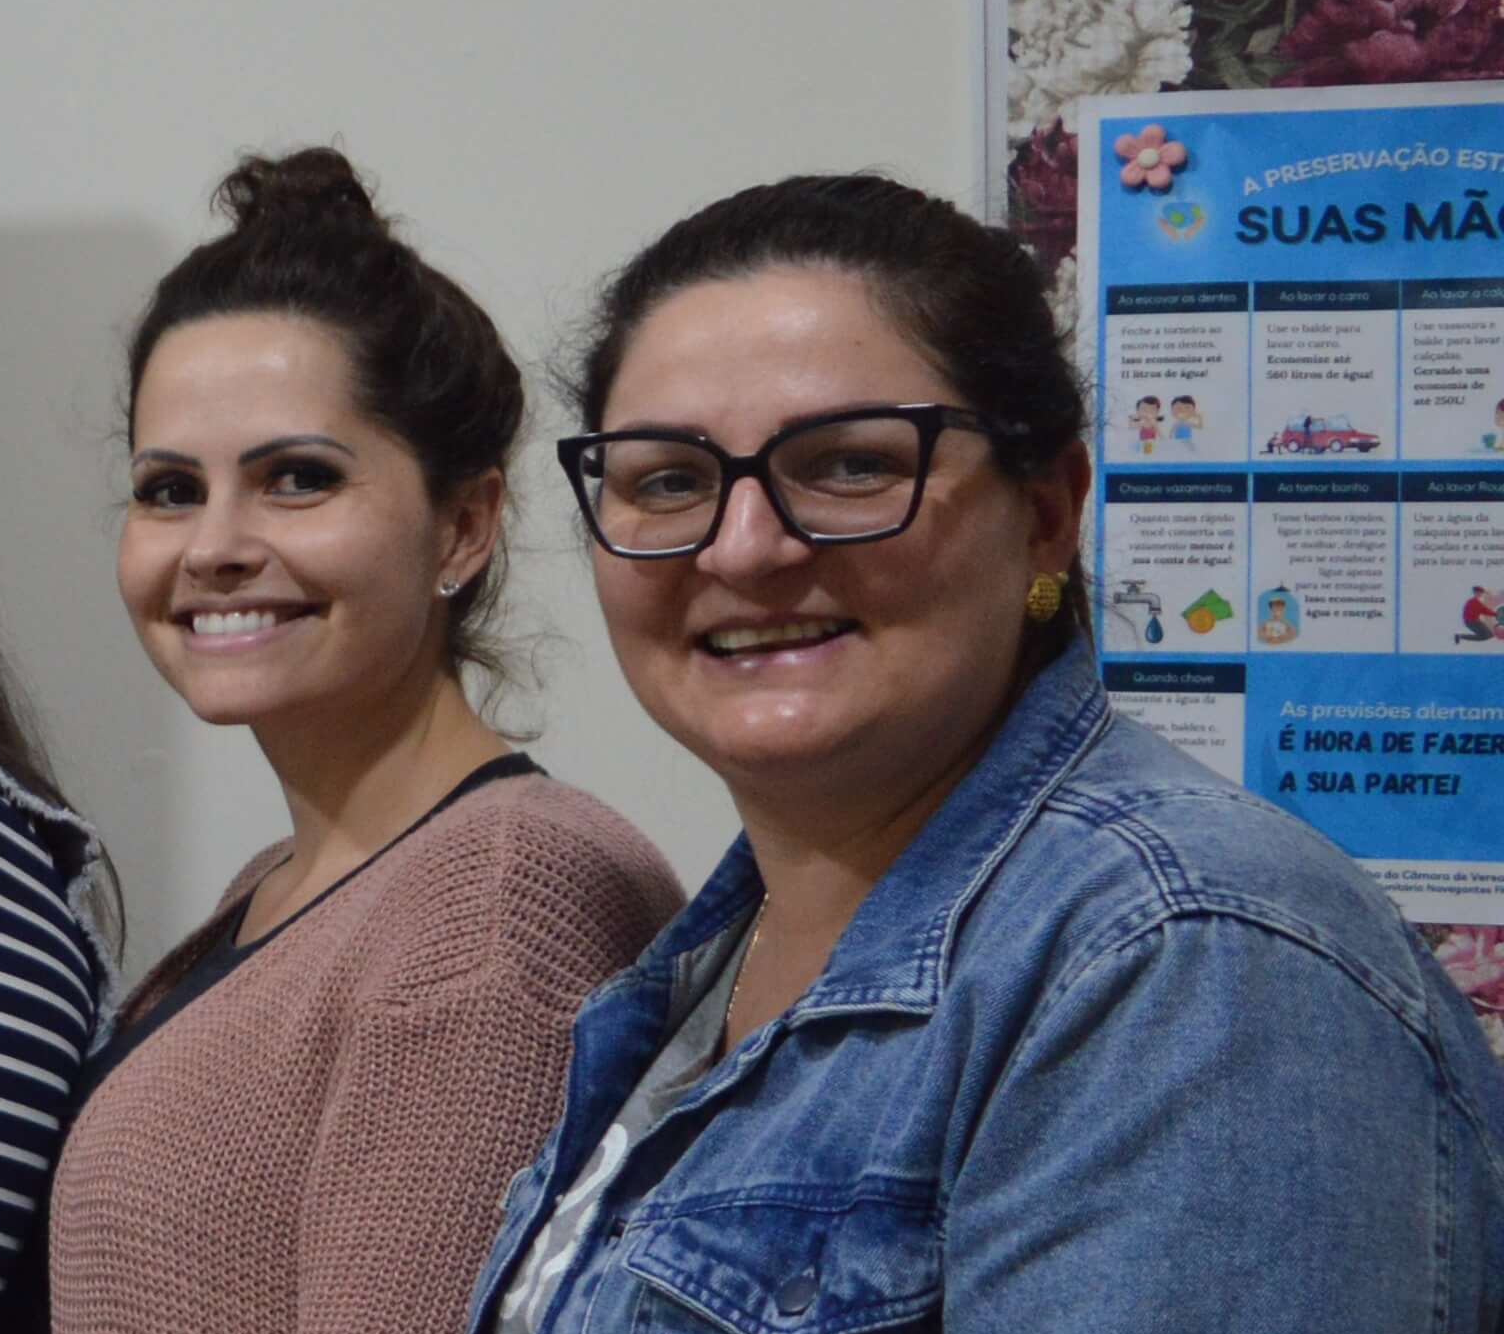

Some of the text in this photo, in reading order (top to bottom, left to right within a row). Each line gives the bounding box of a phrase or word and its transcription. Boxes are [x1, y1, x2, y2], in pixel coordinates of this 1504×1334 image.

[1264, 141, 1451, 188] PRESERVAÇÃO
[1456, 147, 1504, 173] EST
[1236, 188, 1504, 245] SUAS MÃ
[1135, 295, 1178, 305] escovar
[1198, 292, 1236, 303] dentes
[1296, 291, 1326, 301] lavar
[1339, 292, 1369, 301] carro
[1440, 288, 1469, 299] lavar
[1121, 326, 1152, 335] Feche
[1163, 326, 1206, 335] torneira
[1302, 323, 1332, 333] balde
[1121, 341, 1159, 349] escovar
[1267, 338, 1293, 348] lavar
[1414, 335, 1443, 345] balde
[1473, 334, 1500, 344] lavar
[1133, 369, 1161, 378] litros
[1291, 369, 1323, 379] litros
[1343, 368, 1374, 381] água!
[1296, 482, 1329, 492] tomar
[1332, 482, 1368, 492] banho
[1446, 481, 1475, 492] lavar
[1133, 671, 1215, 683] Quando chove
[1280, 700, 1504, 722] As previsões alertam
[1304, 729, 1373, 754] HORA
[1381, 731, 1415, 754] DE
[1306, 770, 1355, 794] SUA
[1364, 773, 1461, 796] PARTE!
